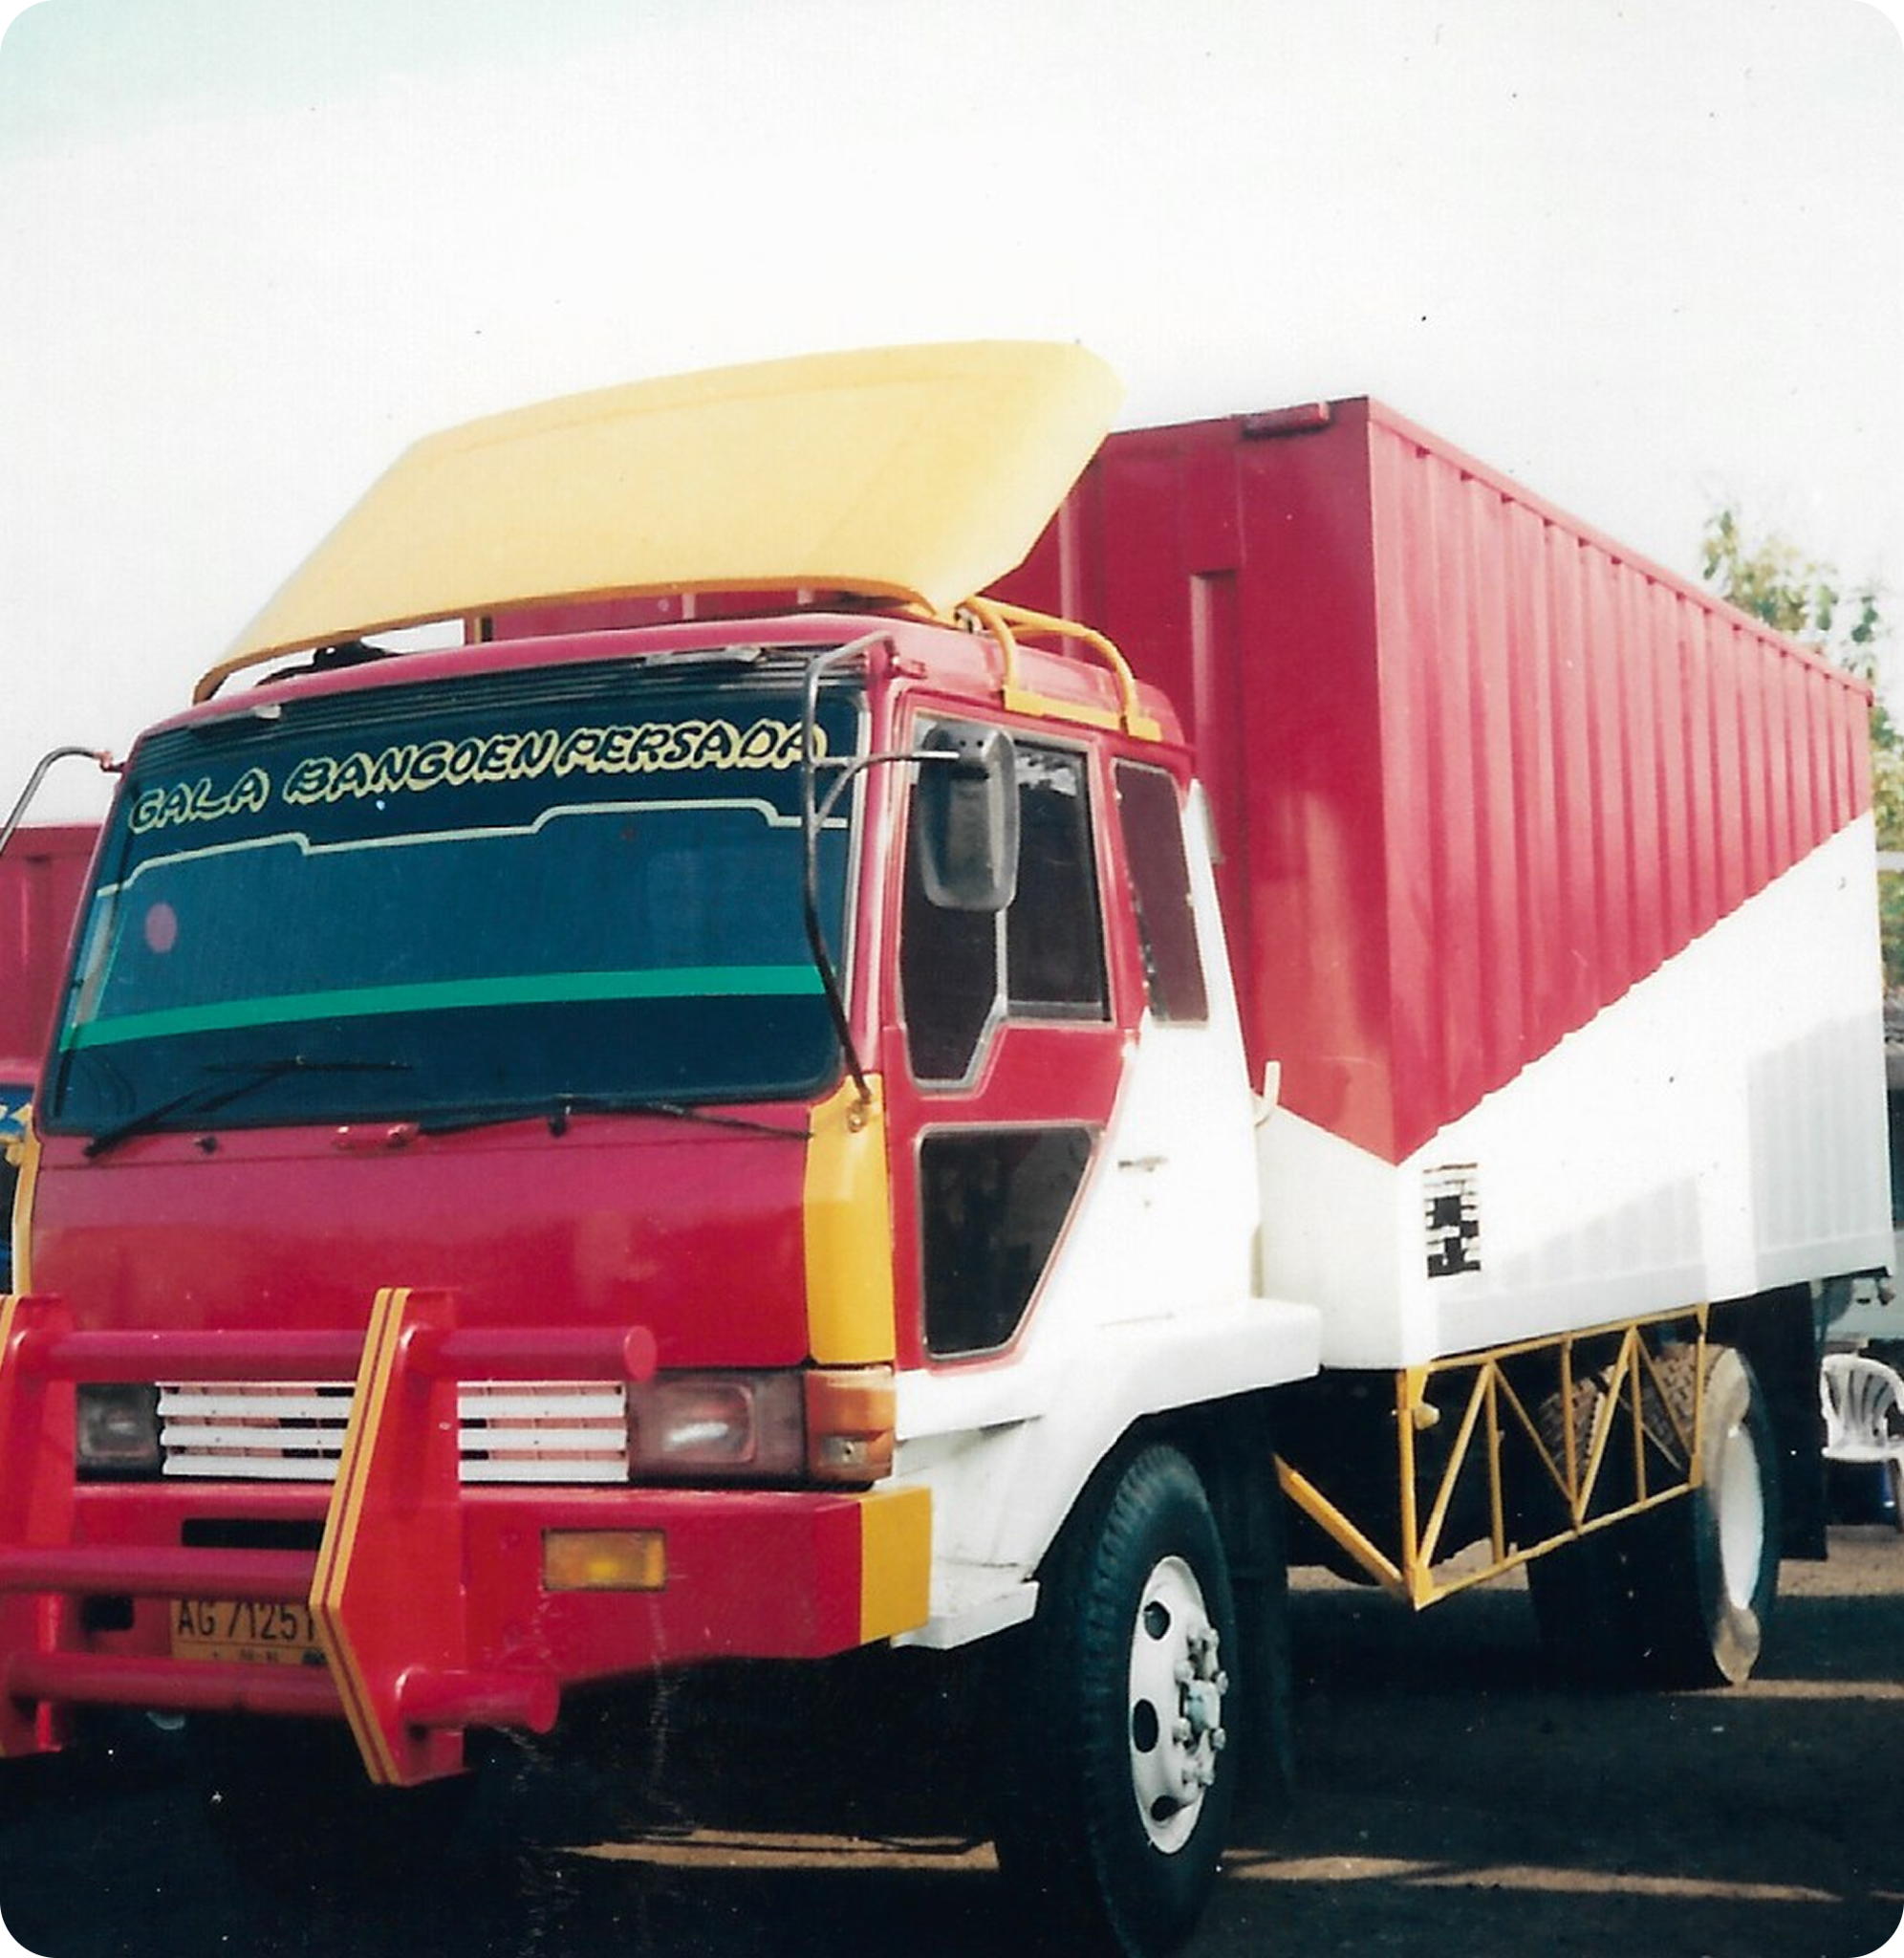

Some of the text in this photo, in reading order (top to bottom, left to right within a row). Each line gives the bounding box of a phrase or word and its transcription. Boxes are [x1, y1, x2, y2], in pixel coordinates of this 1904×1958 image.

[129, 718, 828, 834] GALA BANGOEN PERSADA
[178, 1599, 215, 1636] AG
